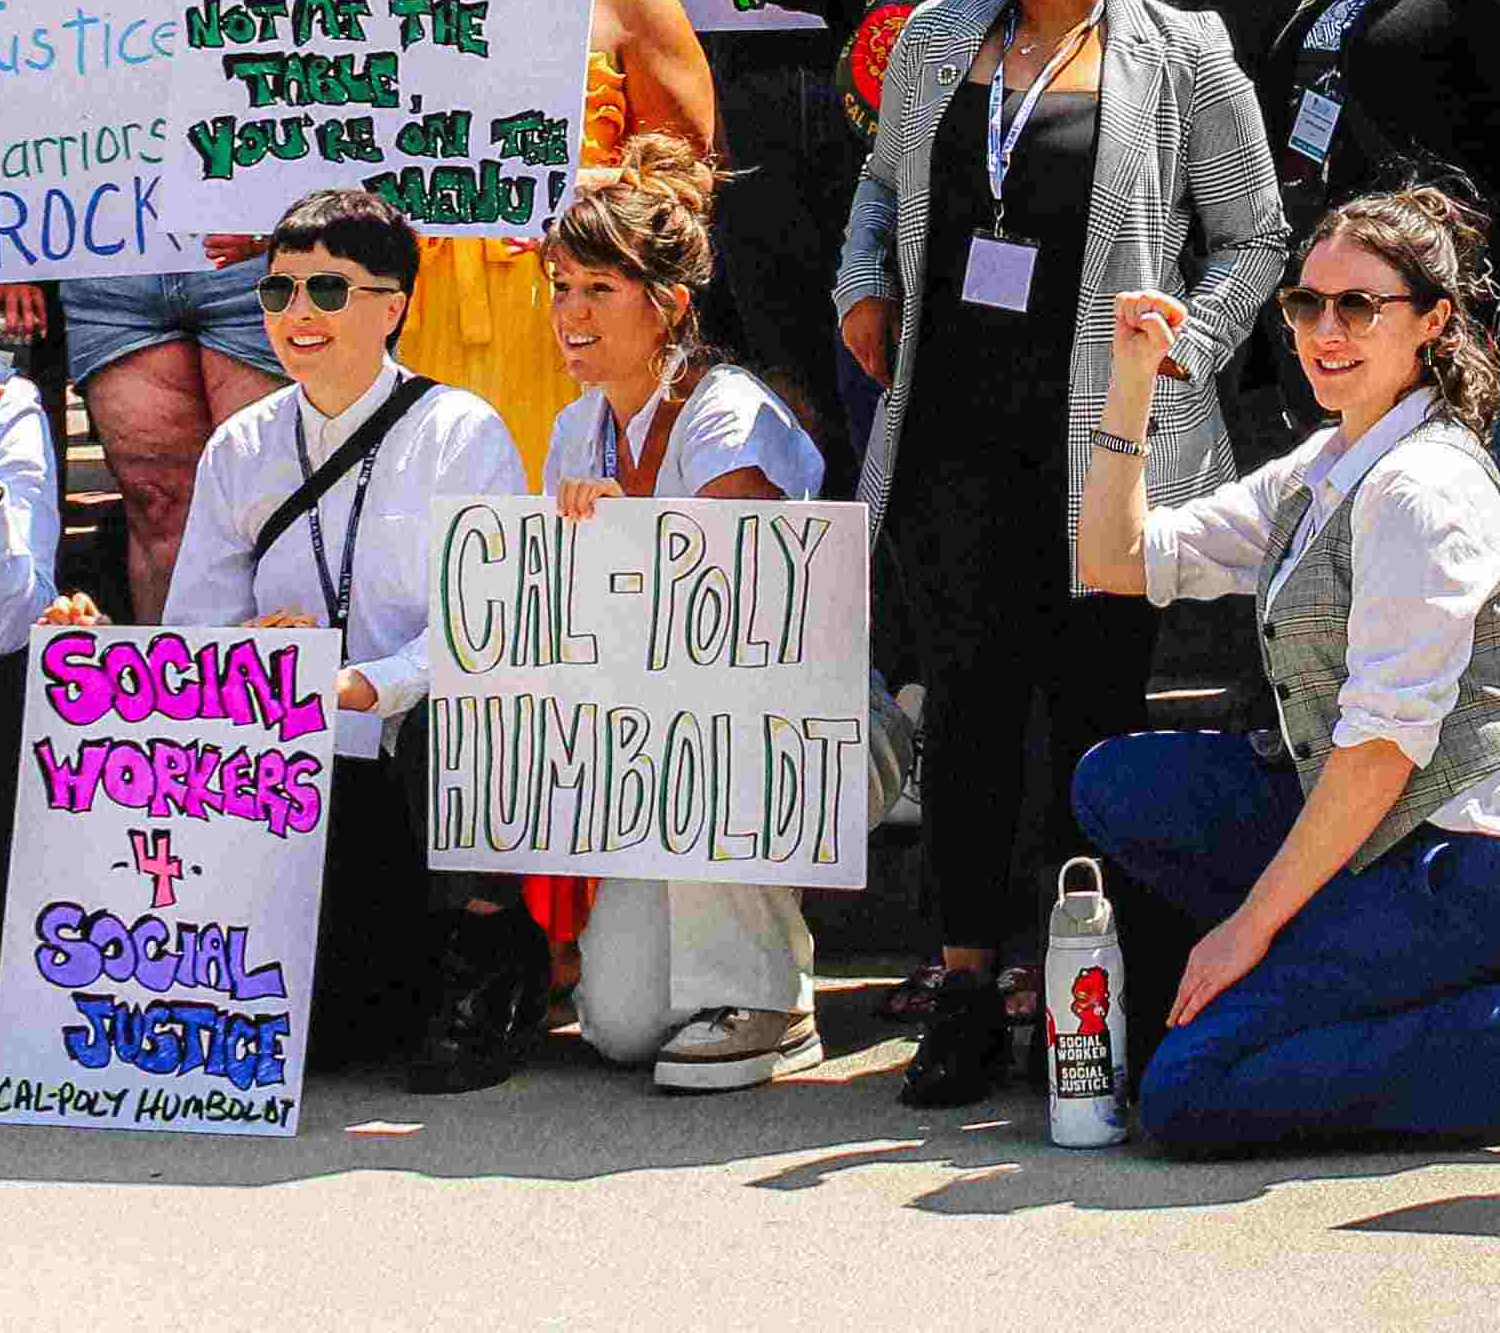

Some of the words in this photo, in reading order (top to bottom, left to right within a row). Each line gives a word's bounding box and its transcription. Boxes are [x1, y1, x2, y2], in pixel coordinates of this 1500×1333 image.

[187, 113, 385, 181] YOU'RE
[395, 111, 473, 158] ON
[490, 109, 569, 165] THE
[42, 630, 329, 742] SOCIAL
[34, 736, 324, 838] WORKERS
[430, 694, 863, 867] HUMBOLDT
[34, 900, 288, 1002] SOCIAL
[63, 992, 294, 1089] JUSTICE
[1057, 1047, 1107, 1060] WORKER
[1059, 1034, 1103, 1048] SOCIAL
[1061, 1066, 1105, 1079] SOCIAL
[136, 1085, 295, 1128] HUMBOLDT
[1059, 1077, 1109, 1093] JUSTICE
